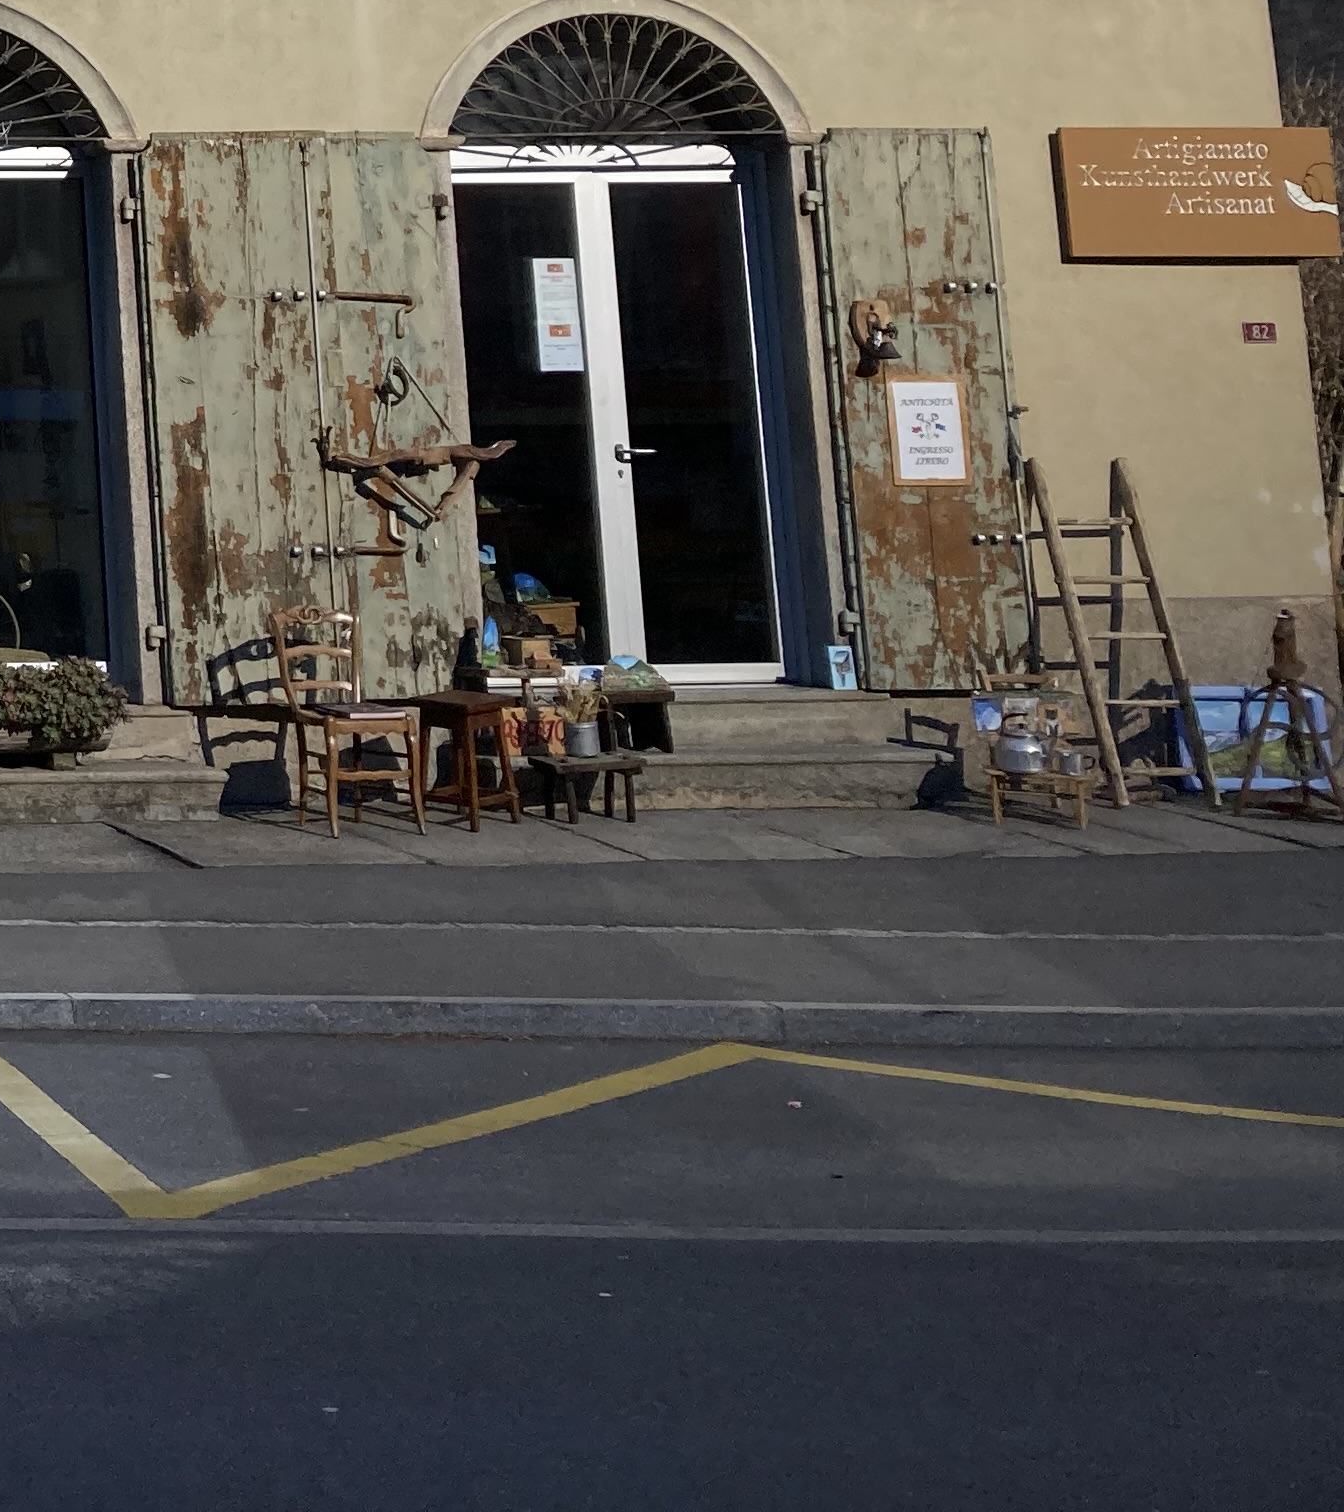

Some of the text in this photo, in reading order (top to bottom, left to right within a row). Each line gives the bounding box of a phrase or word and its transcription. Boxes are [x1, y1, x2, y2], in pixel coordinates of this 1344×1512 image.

[1132, 135, 1269, 165] Artigianato
[1078, 164, 1274, 187] Kunsthandwerk
[1165, 190, 1275, 215] Artisanat
[1252, 324, 1270, 339] 82
